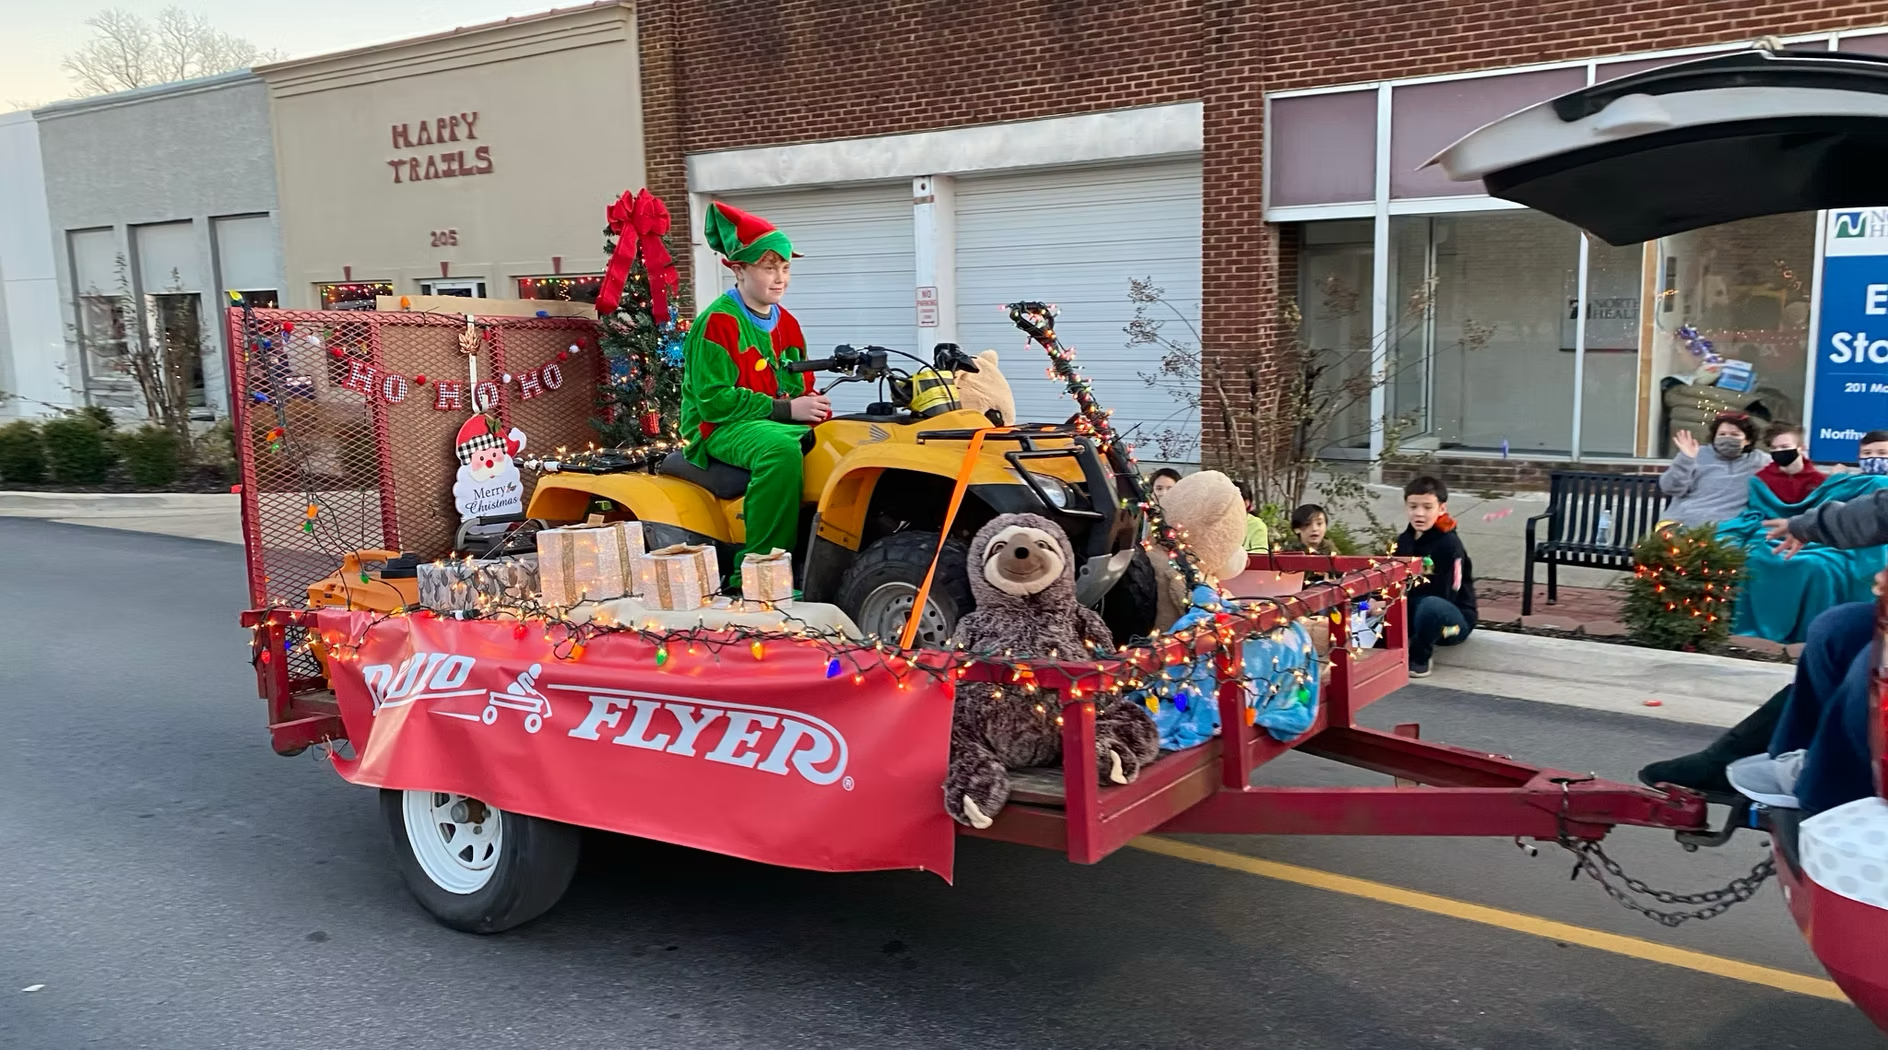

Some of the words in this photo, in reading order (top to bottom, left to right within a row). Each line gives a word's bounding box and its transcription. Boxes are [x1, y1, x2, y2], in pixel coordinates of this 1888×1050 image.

[391, 111, 478, 149] HAPPY
[386, 146, 494, 184] TRAILS
[430, 229, 458, 248] 205
[344, 360, 408, 403] HO
[437, 381, 499, 409] HO
[517, 363, 563, 400] HO
[1844, 382, 1867, 393] 201
[465, 496, 518, 514] Christmas
[473, 486, 506, 500] Merry
[568, 695, 849, 786] FLYER
